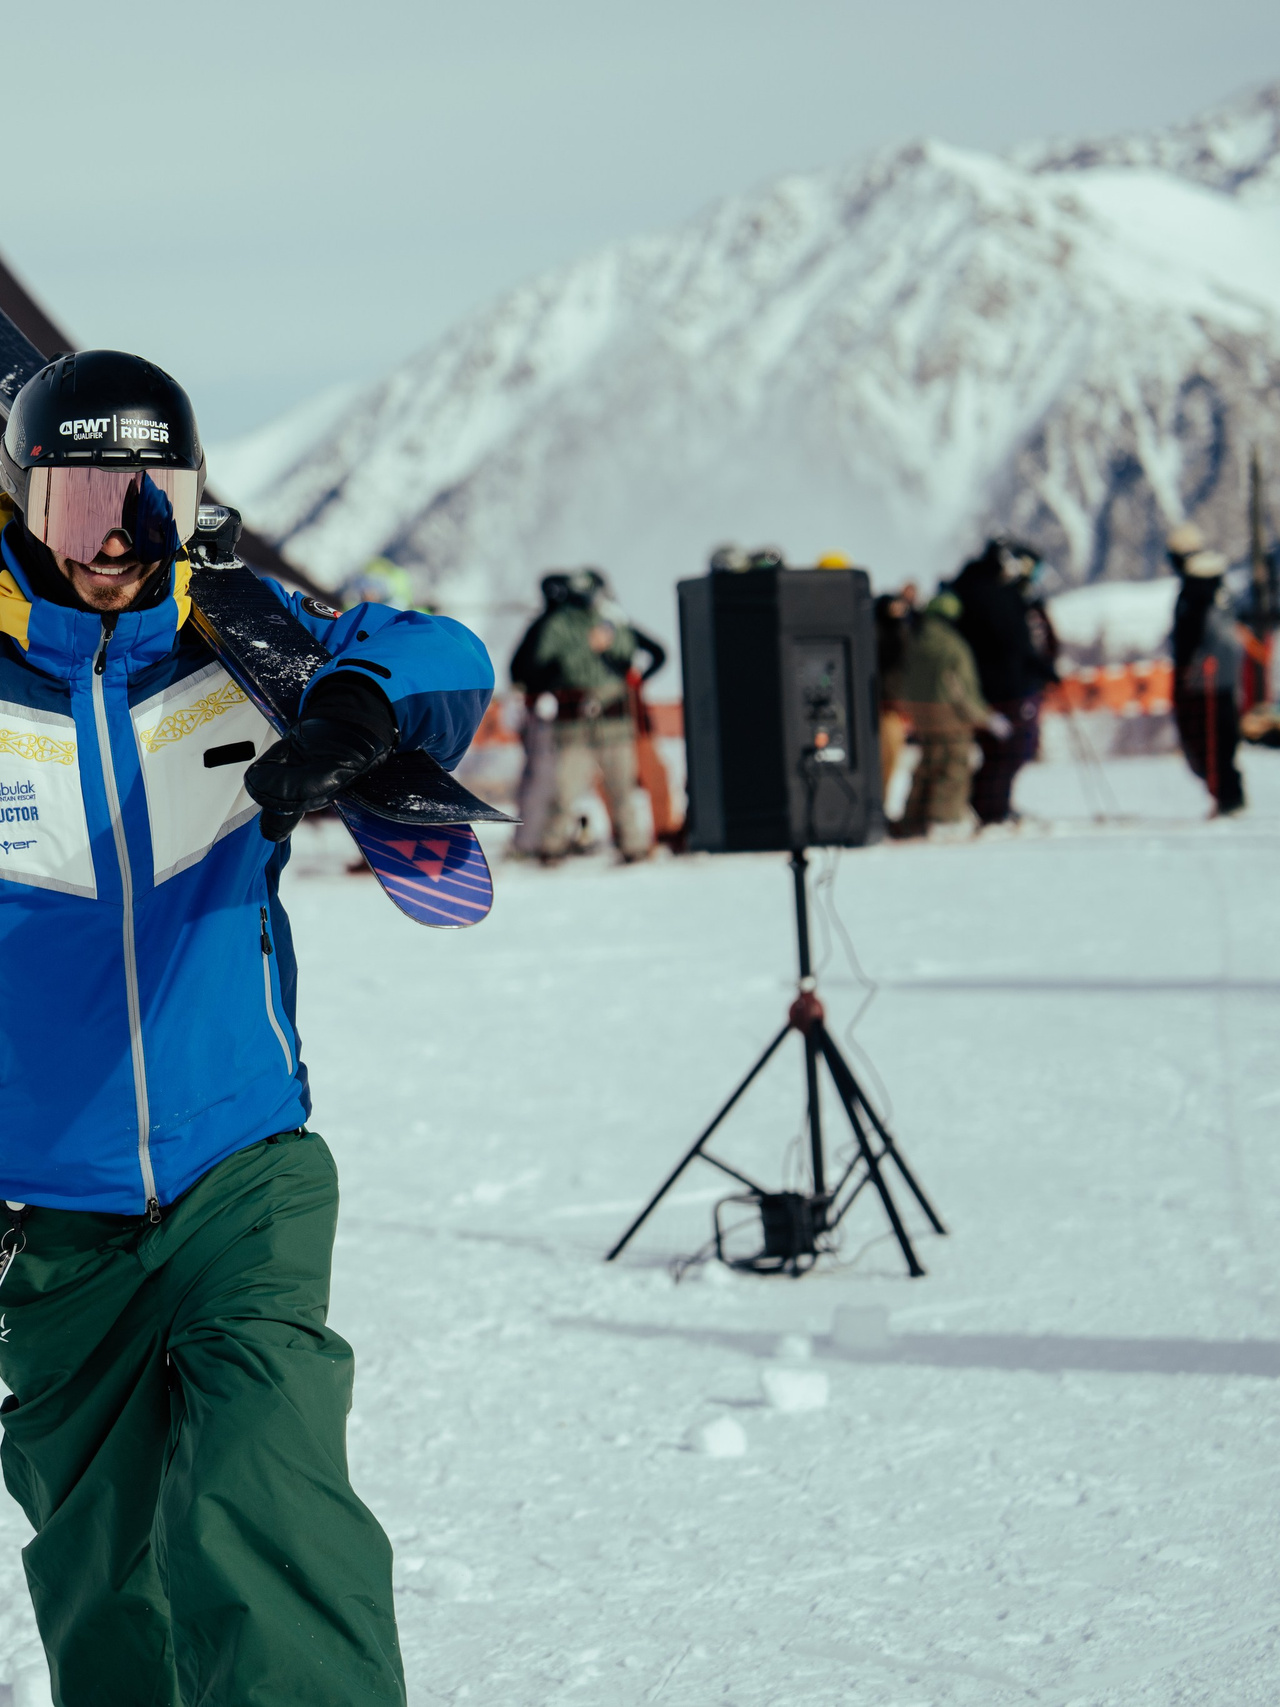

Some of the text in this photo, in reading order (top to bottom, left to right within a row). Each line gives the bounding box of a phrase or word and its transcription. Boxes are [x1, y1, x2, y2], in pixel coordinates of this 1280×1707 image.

[73, 418, 111, 434] FWT
[120, 418, 169, 430] SHYMBULAK
[73, 431, 103, 441] QUALIFIER
[120, 426, 169, 444] RIDER
